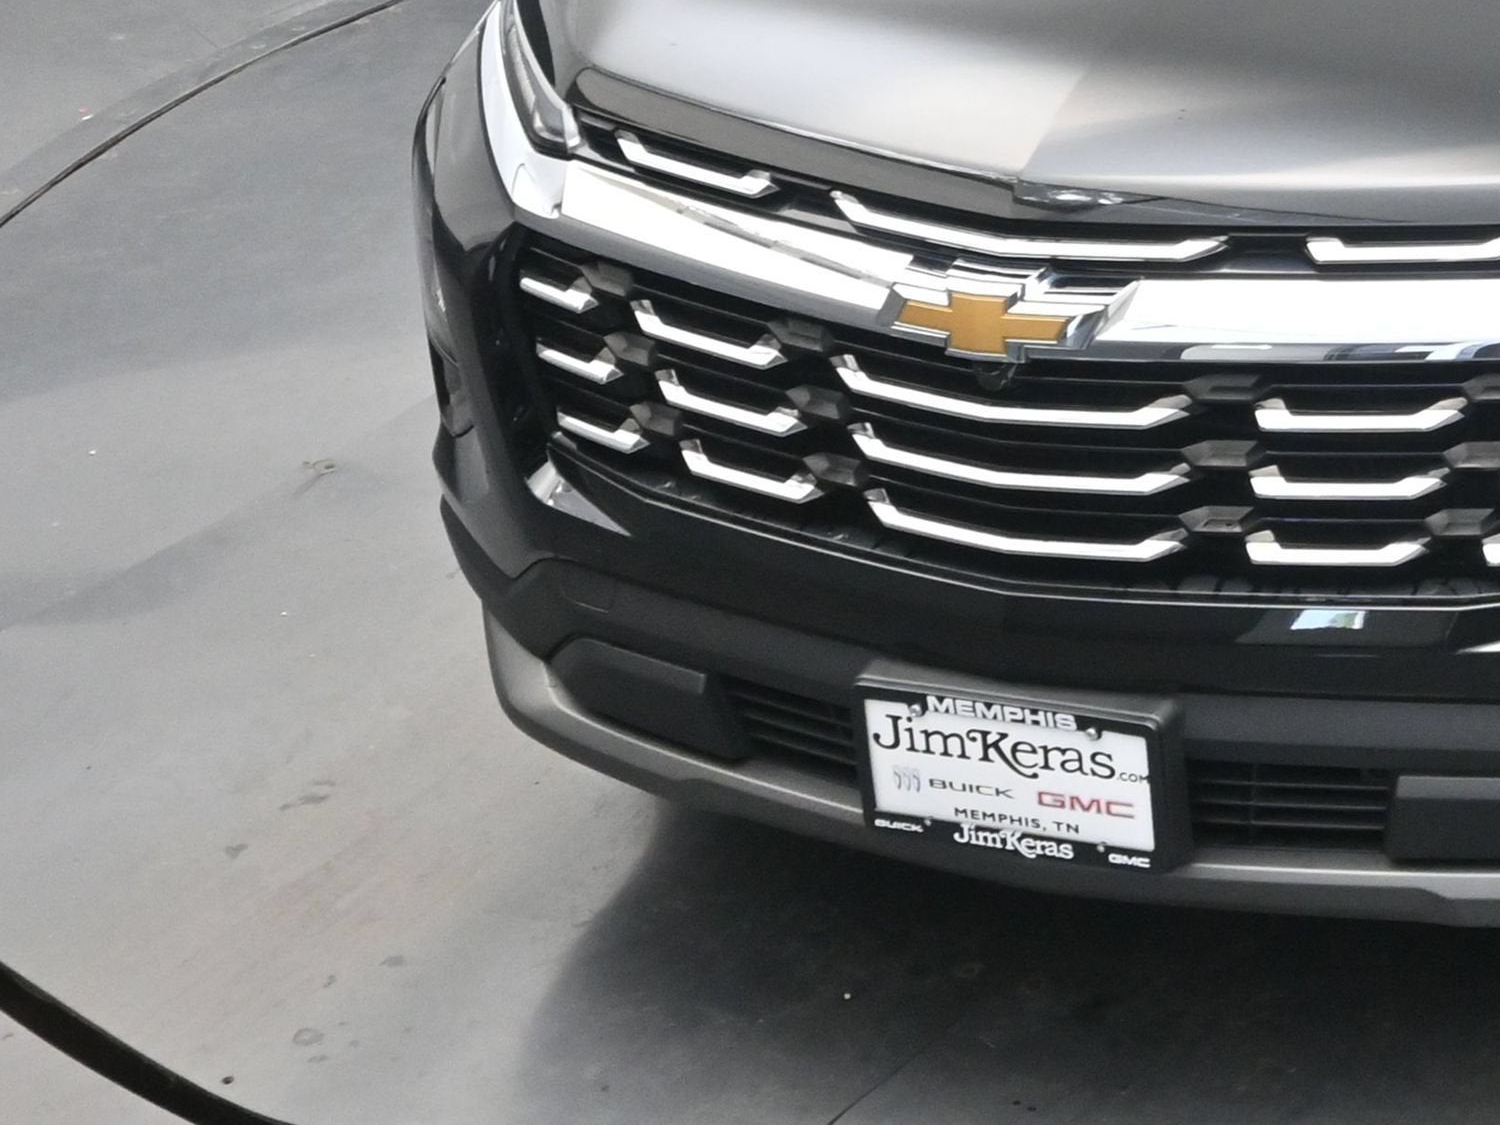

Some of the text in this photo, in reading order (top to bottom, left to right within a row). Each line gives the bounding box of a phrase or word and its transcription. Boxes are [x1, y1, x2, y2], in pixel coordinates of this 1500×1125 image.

[926, 695, 1077, 731] MEMPHIS
[929, 778, 1135, 819] BUICK GMC
[874, 818, 924, 833] BUICK
[954, 807, 1080, 834] MEMPHIS, TN
[1108, 853, 1151, 868] GMC
